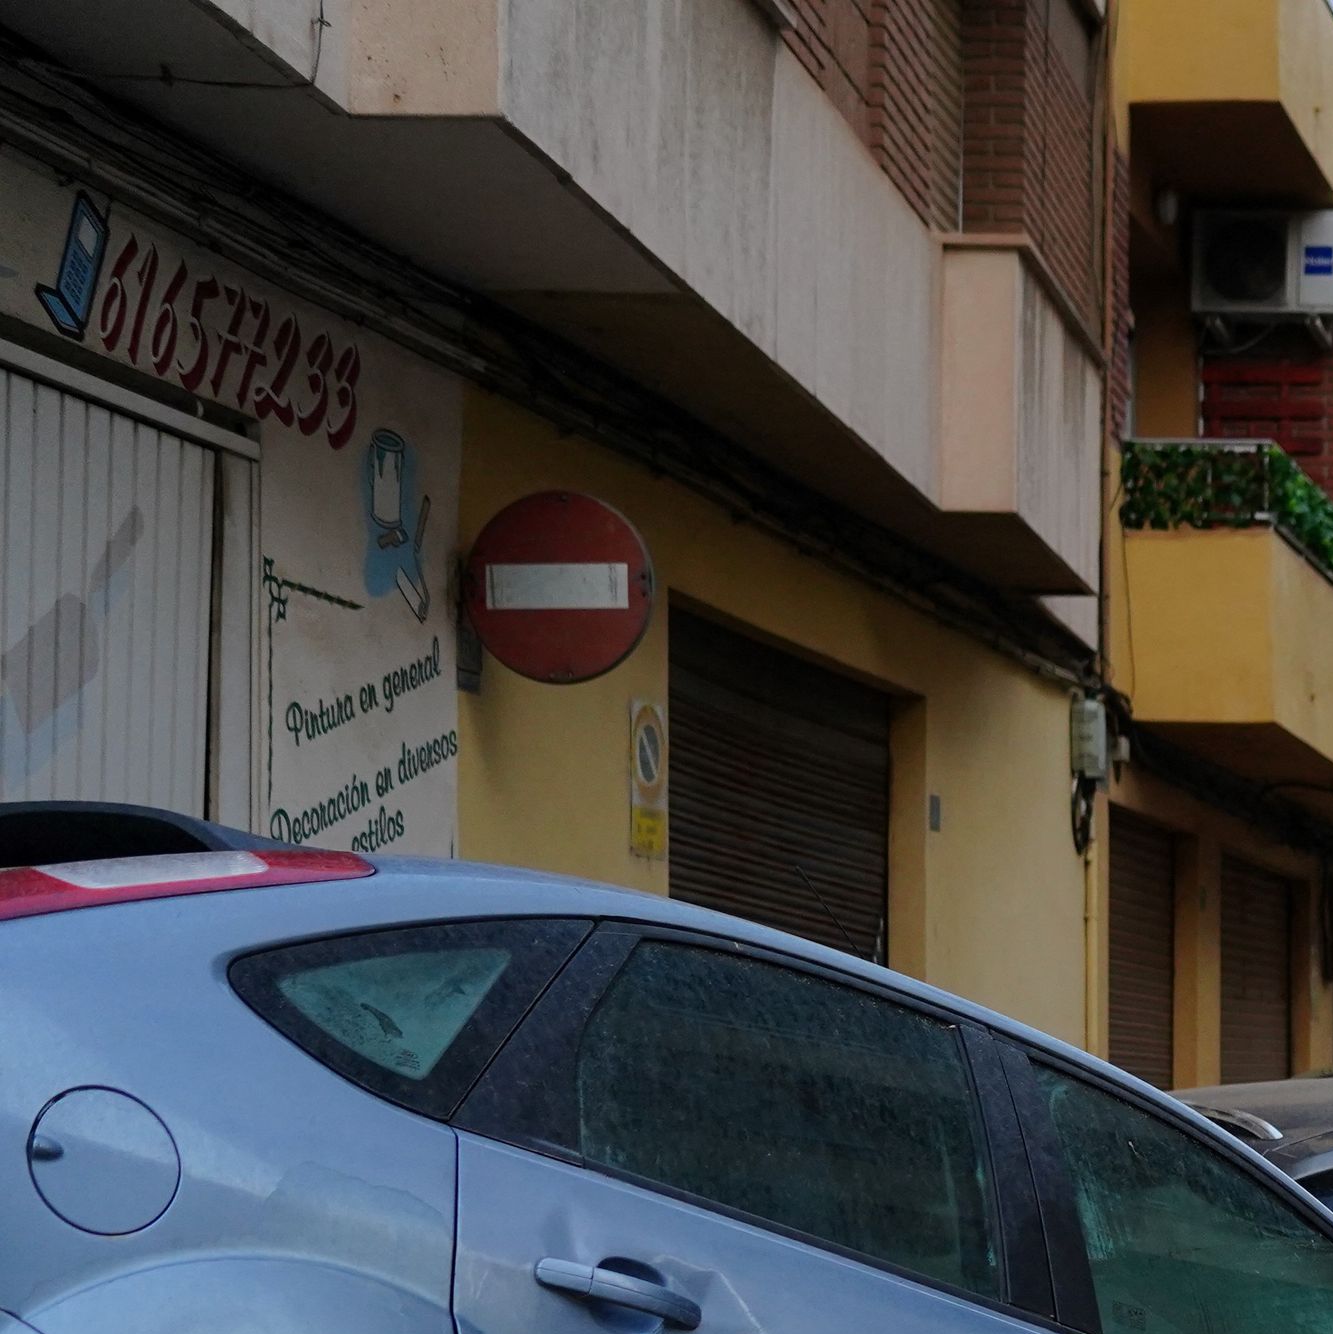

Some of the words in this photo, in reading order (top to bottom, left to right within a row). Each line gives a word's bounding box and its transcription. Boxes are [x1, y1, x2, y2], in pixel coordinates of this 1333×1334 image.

[100, 232, 361, 450] 616577233
[286, 694, 356, 747] Pintura
[359, 682, 380, 714] en
[383, 636, 442, 714] general
[270, 774, 372, 847] Decoración
[375, 766, 395, 798] en
[398, 730, 458, 785] diversos
[351, 806, 405, 853] estilos
